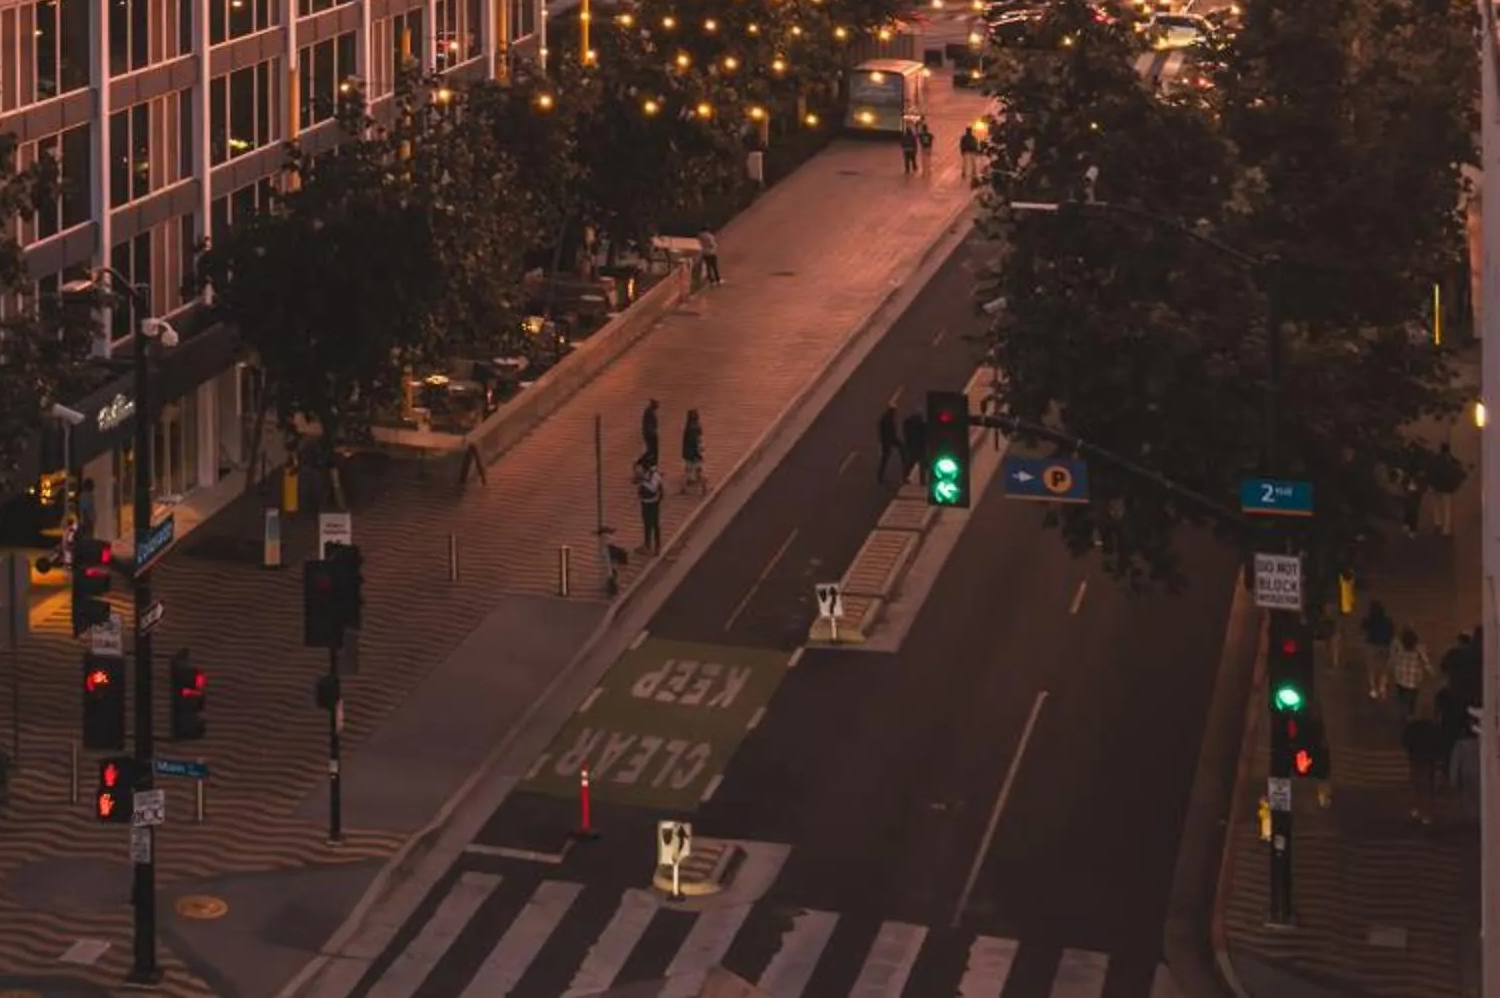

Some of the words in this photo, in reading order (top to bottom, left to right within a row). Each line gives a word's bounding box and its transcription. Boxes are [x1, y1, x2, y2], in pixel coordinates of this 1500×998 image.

[1256, 561, 1274, 575] DO
[1277, 563, 1299, 578] NOT
[1258, 577, 1299, 594] BLOCK
[631, 658, 751, 708] KEEP
[554, 727, 712, 790] CLEAR
